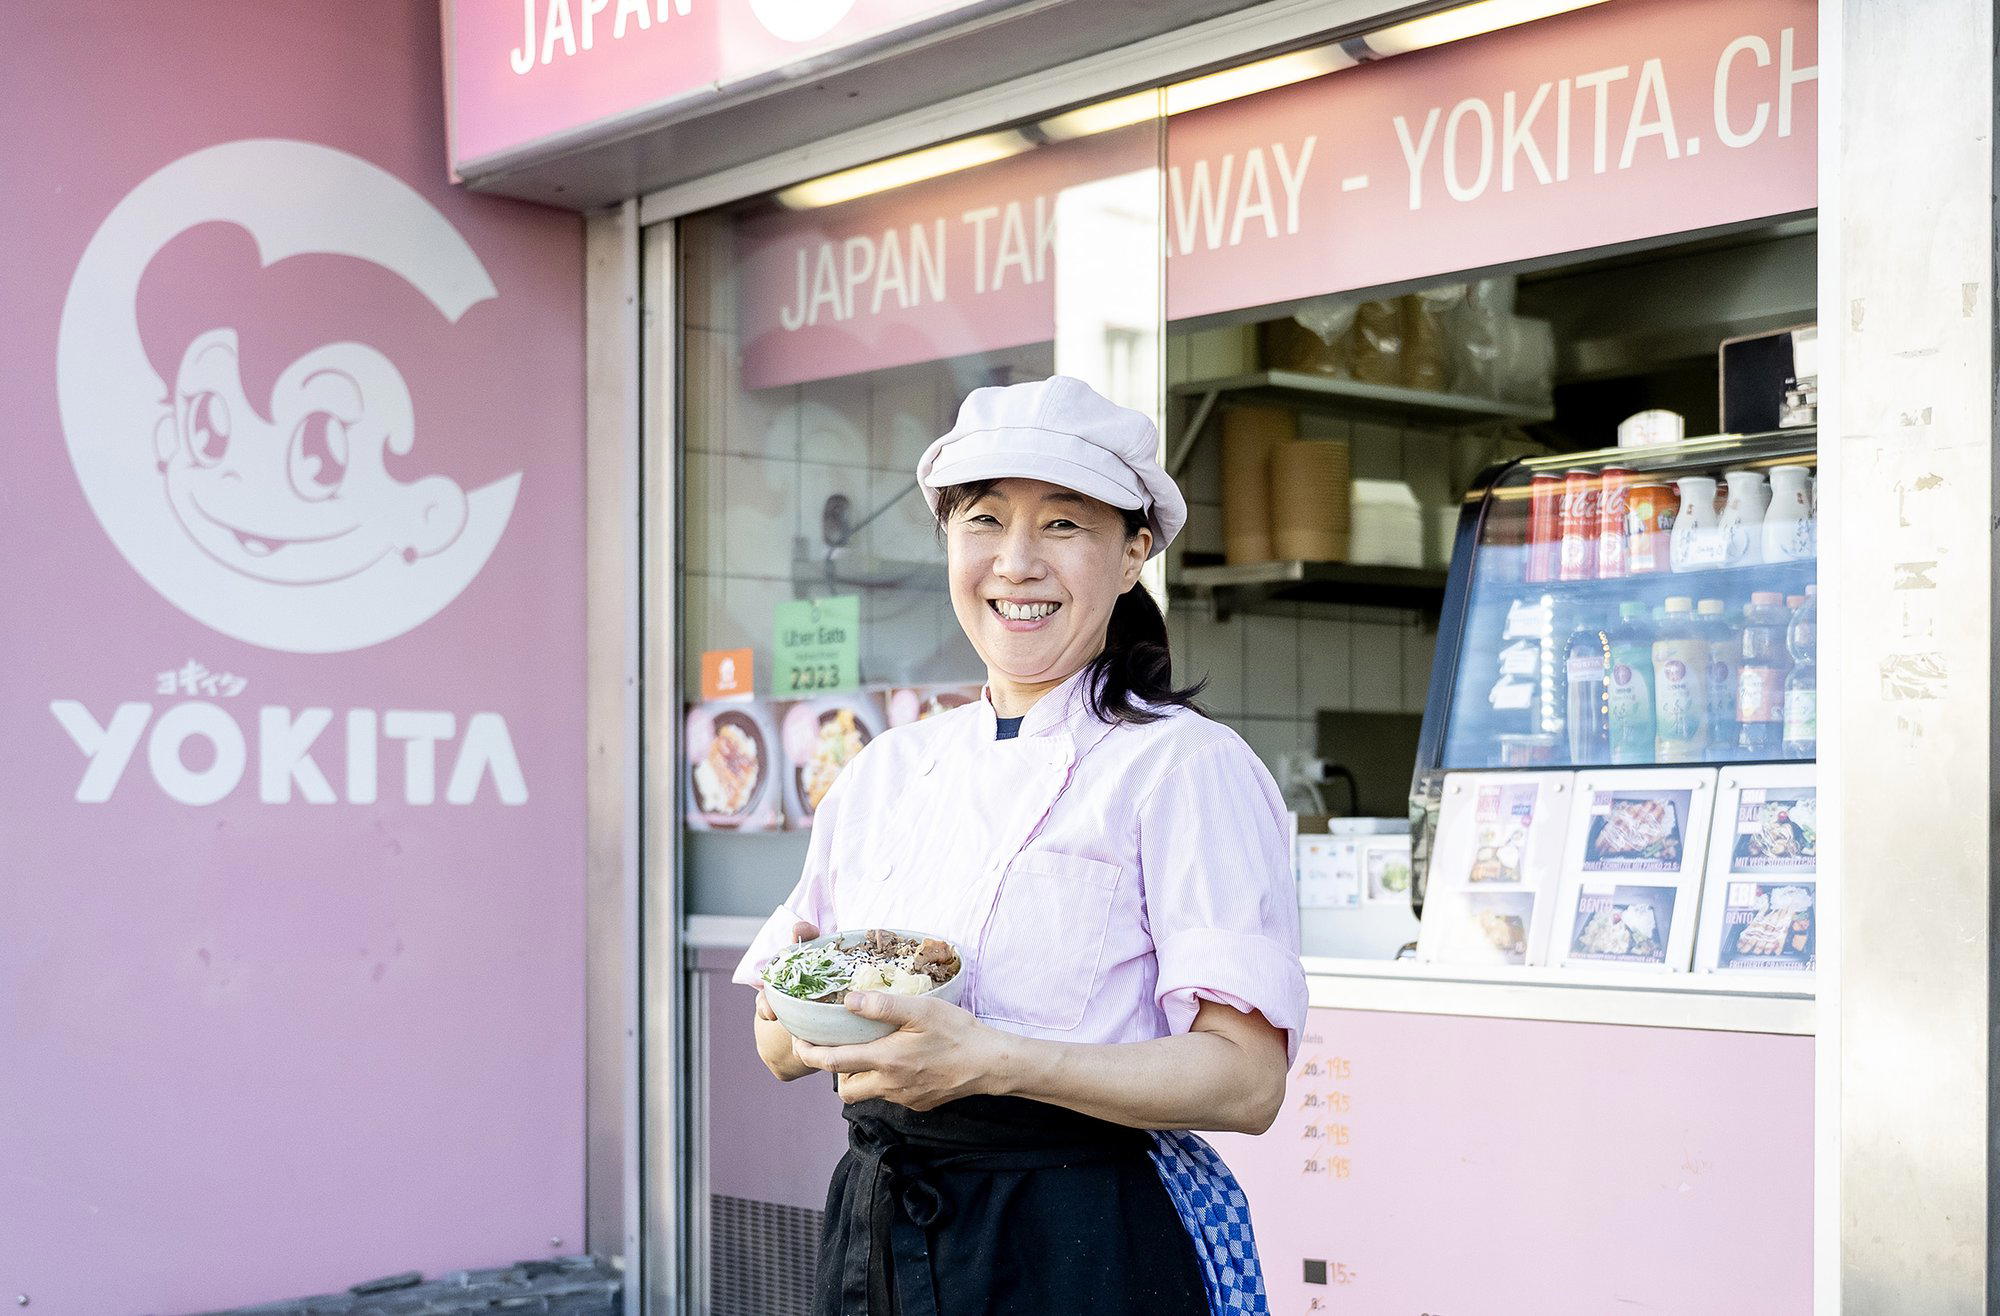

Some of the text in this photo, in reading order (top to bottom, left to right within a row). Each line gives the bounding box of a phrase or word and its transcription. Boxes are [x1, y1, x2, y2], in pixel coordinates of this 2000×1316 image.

[510, 0, 694, 76] JAP
[779, 217, 948, 332] JAPAN
[1393, 26, 1818, 211] YOKITA.CH
[817, 625, 847, 645] Eats
[790, 664, 840, 690] 2023
[49, 700, 530, 807] YOKITA
[1579, 897, 1612, 913] BENTO
[1726, 911, 1753, 925] BENTO
